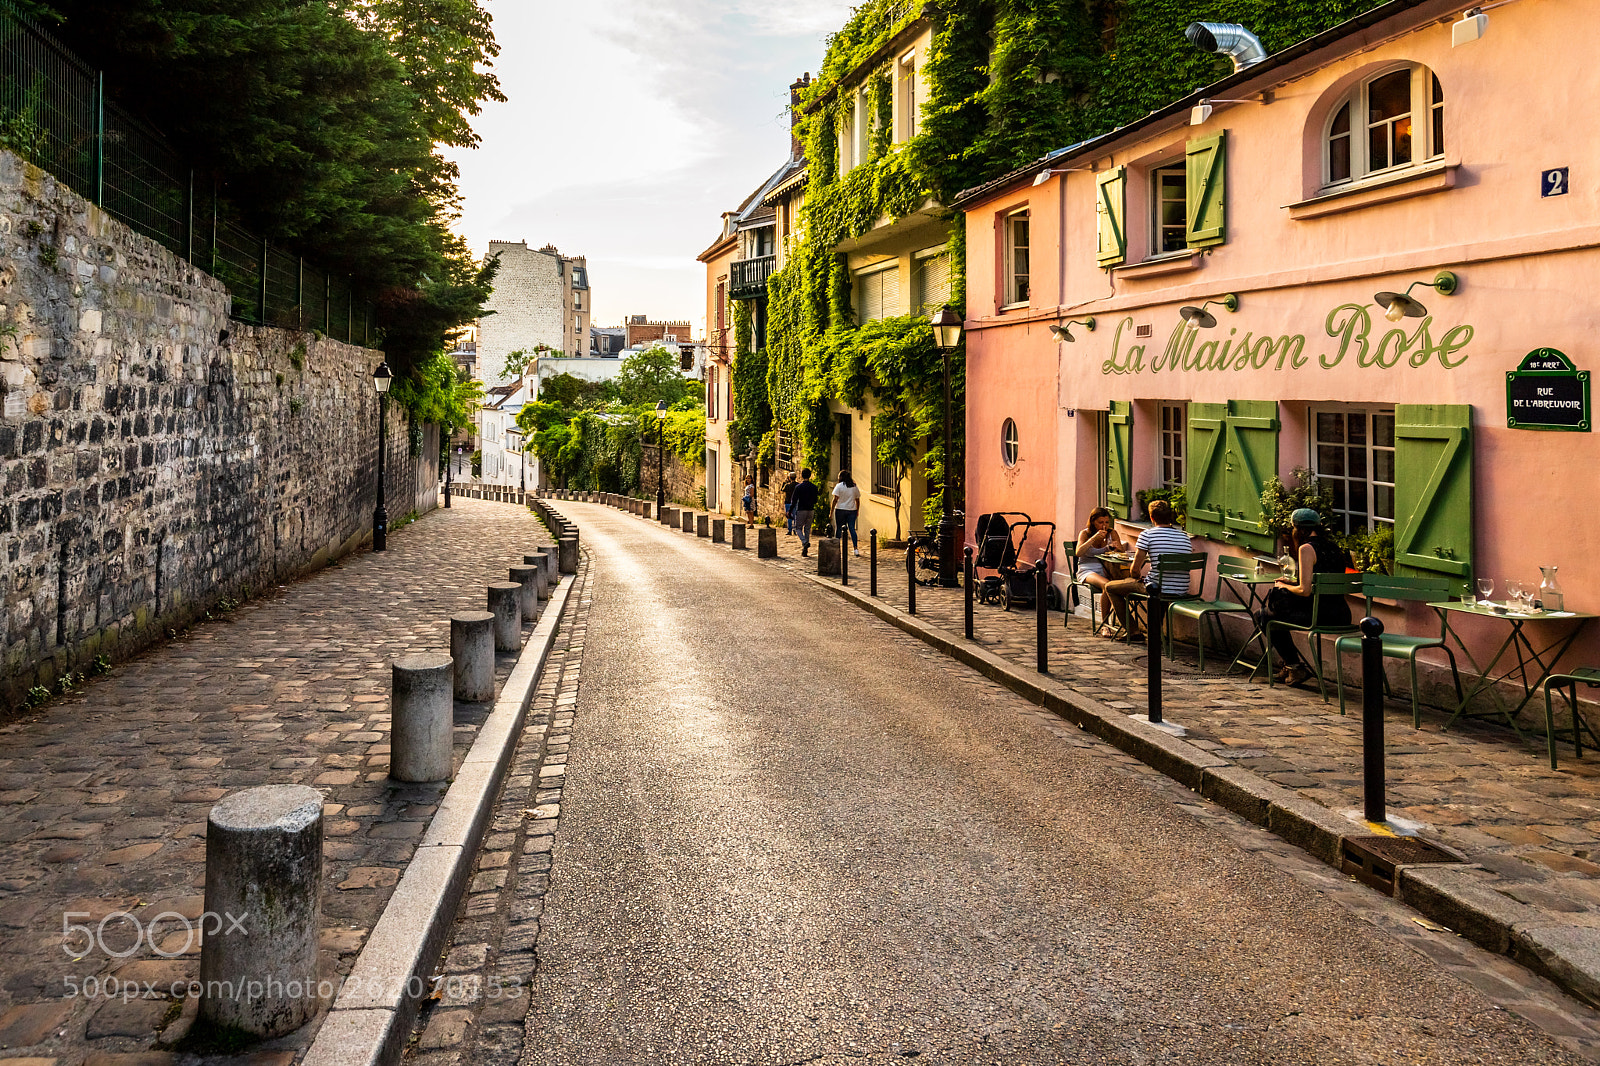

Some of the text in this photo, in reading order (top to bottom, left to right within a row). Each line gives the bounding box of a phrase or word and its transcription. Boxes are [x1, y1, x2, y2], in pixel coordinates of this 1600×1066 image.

[1547, 170, 1562, 195] 2
[1102, 303, 1474, 374] La Maison Rose
[1537, 387, 1554, 396] RUE
[1513, 399, 1581, 409] DE L'ABREUVOIR
